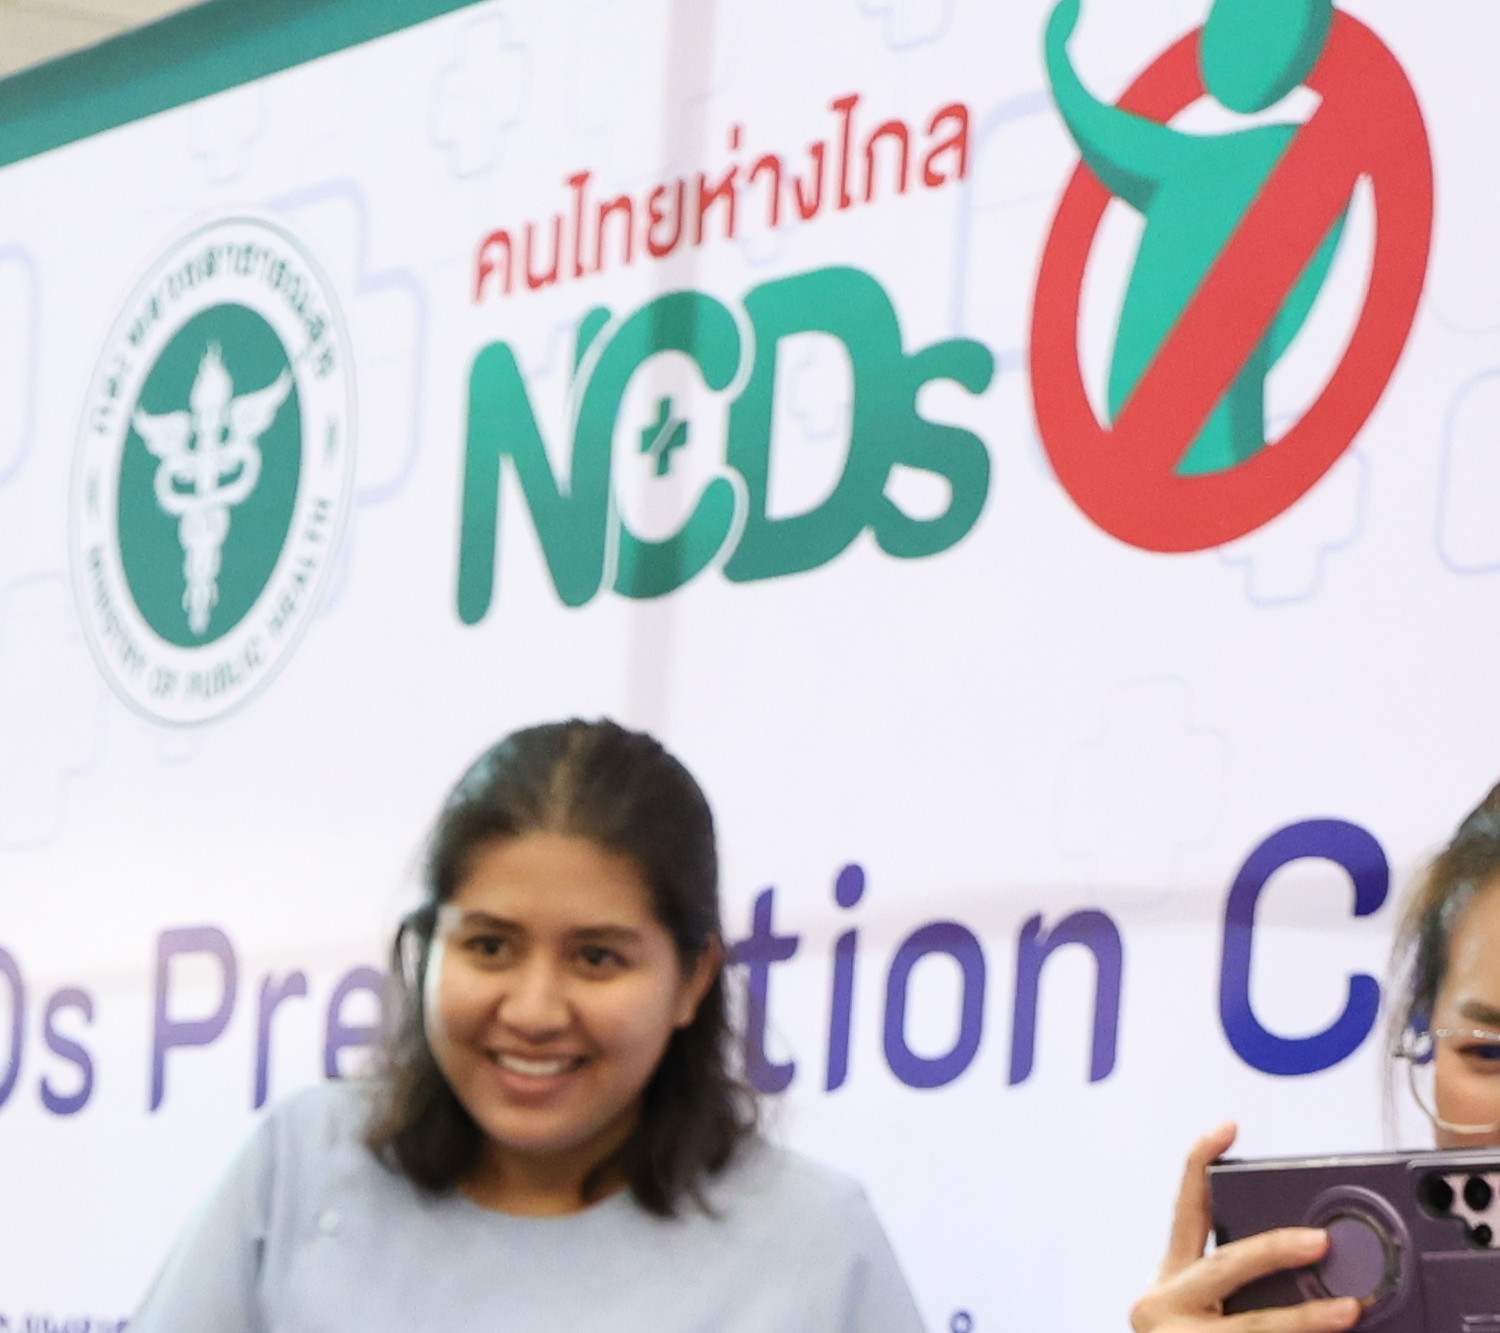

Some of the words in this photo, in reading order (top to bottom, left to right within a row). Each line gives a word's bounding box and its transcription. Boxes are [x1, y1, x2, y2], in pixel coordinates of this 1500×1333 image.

[474, 94, 970, 304] คนไทยห่างไกล
[458, 265, 995, 626] NCDs
